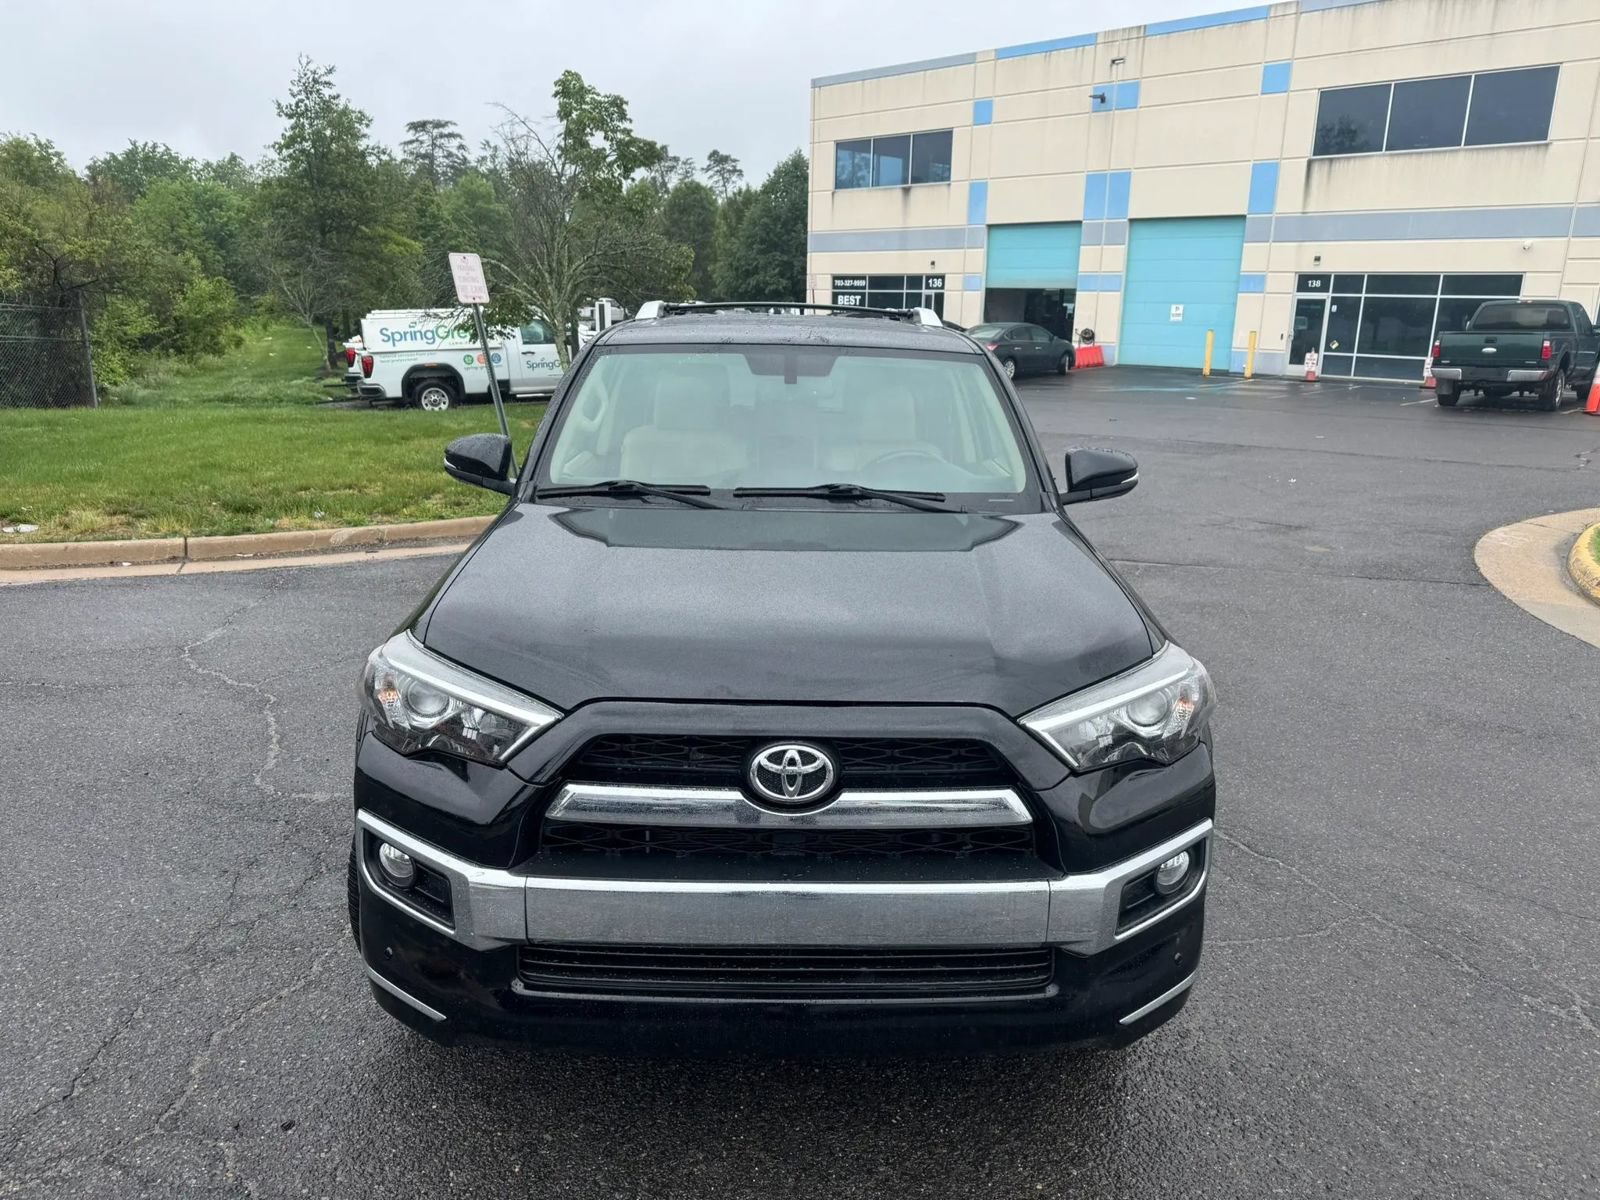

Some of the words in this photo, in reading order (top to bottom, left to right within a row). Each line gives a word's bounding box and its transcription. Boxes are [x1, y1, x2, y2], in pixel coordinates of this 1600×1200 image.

[928, 278, 942, 287] 136
[1307, 280, 1321, 288] 138
[838, 295, 861, 305] BEST
